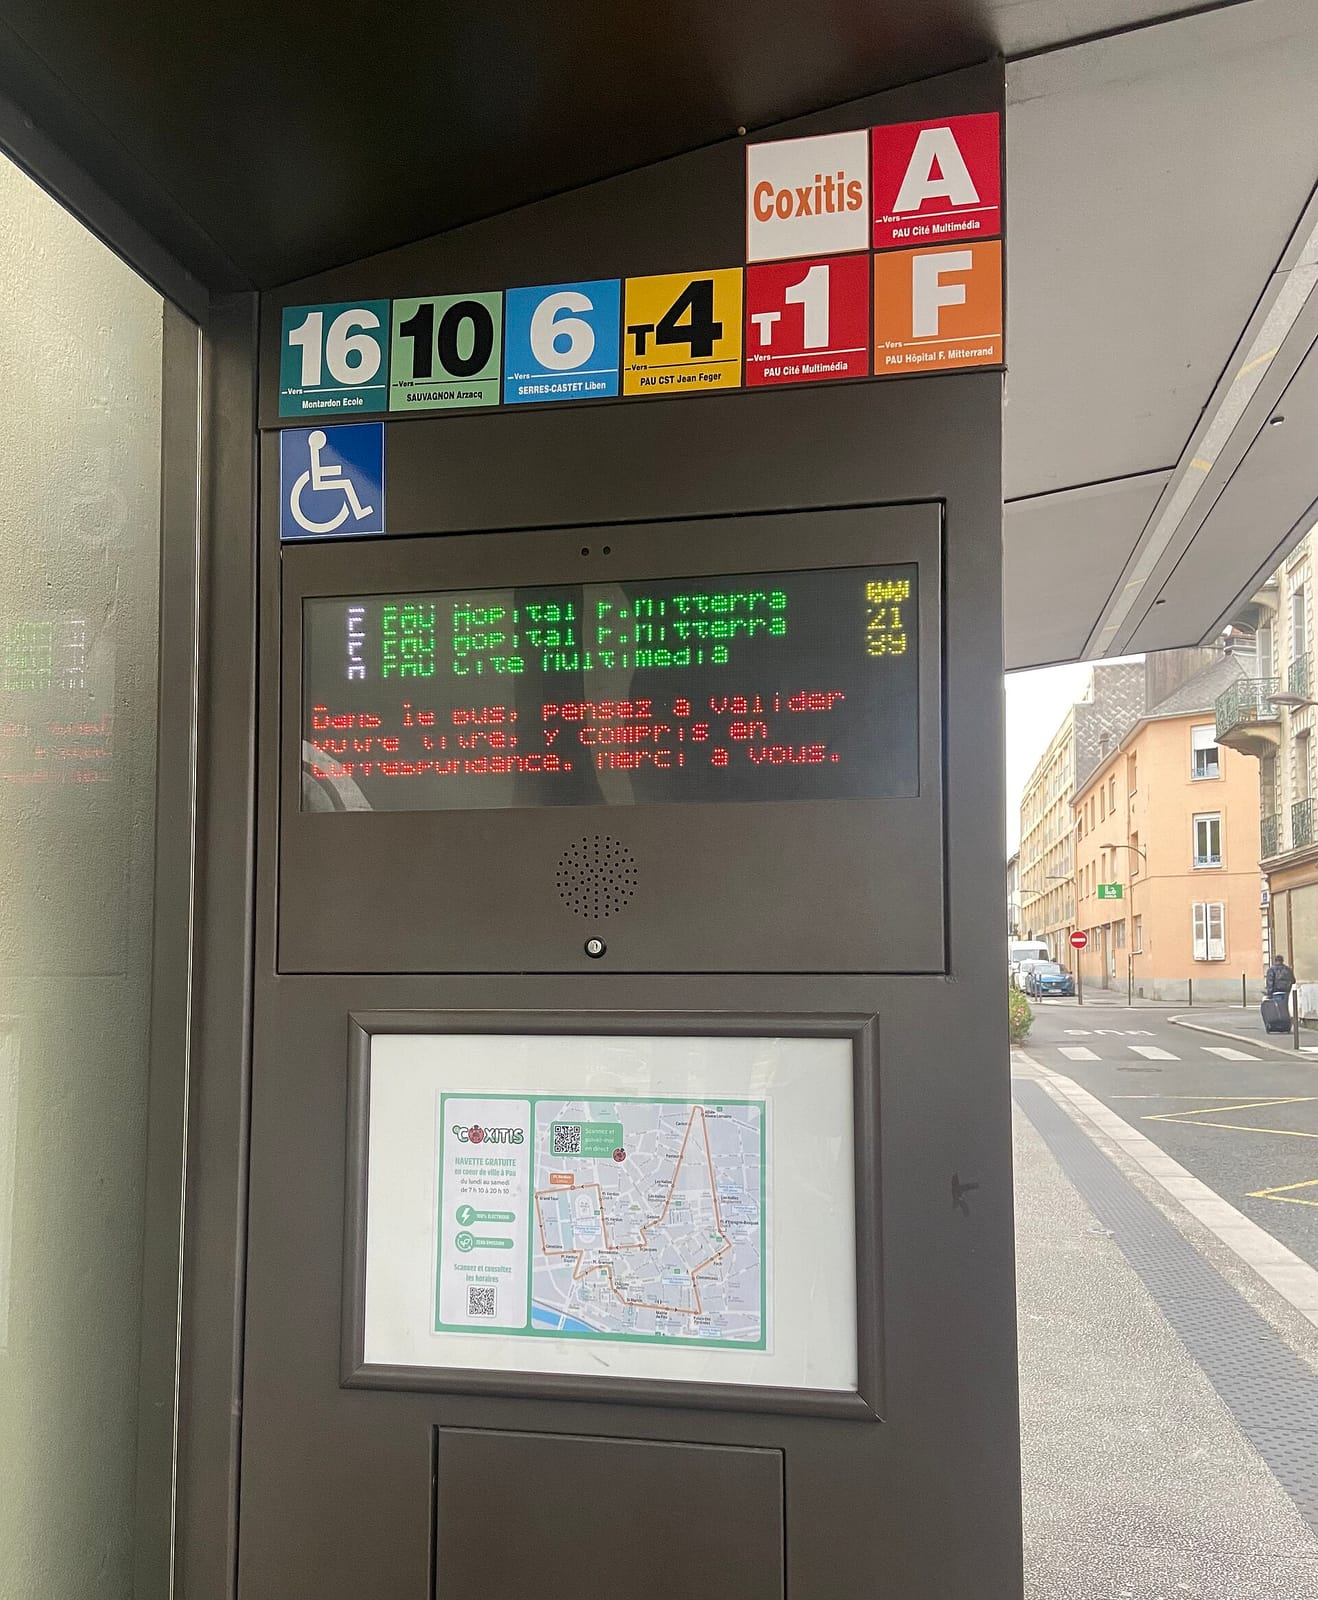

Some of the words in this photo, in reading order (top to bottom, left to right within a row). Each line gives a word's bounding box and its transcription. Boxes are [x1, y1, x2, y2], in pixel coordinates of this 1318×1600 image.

[892, 127, 980, 213] A
[753, 171, 863, 223] Coxitis
[882, 215, 900, 223] Vers
[893, 227, 910, 239] PAU
[912, 224, 930, 236] Cité
[932, 220, 980, 235] Multimédia
[912, 250, 973, 338] F
[400, 300, 494, 379] 10
[529, 291, 596, 371] 6
[289, 308, 382, 387] 16
[885, 340, 903, 349] Vers
[754, 353, 771, 362] Vers
[885, 353, 904, 365] PAU
[905, 352, 937, 365] Hôpital
[938, 351, 946, 361] F.
[948, 347, 994, 360] Mitterrand
[631, 363, 648, 372] Vers
[763, 366, 782, 378] PAU
[783, 364, 801, 376] Cité
[802, 361, 848, 374] Multimédia
[399, 380, 414, 389] Vers
[514, 372, 531, 381] Vers
[640, 375, 657, 387] PAU
[658, 375, 675, 386] CST
[676, 374, 697, 384] Jean
[698, 372, 722, 384] Feger
[288, 387, 303, 396] Vers
[406, 390, 455, 402] SAUVAGNON
[456, 389, 483, 401] Arzacq
[518, 381, 584, 395] SERRES-CASTET
[585, 380, 607, 391] Liben
[302, 397, 341, 409] Montardon
[342, 396, 363, 408] Ecole
[867, 607, 902, 629] 21
[542, 700, 652, 721] pensez
[710, 690, 845, 714] valider
[579, 723, 709, 746] compris
[729, 721, 768, 740] en
[749, 744, 840, 765] vous.
[452, 1125, 524, 1144] COXITIS
[455, 1157, 484, 1166] NAVETTE
[485, 1158, 517, 1167] GRATUITE
